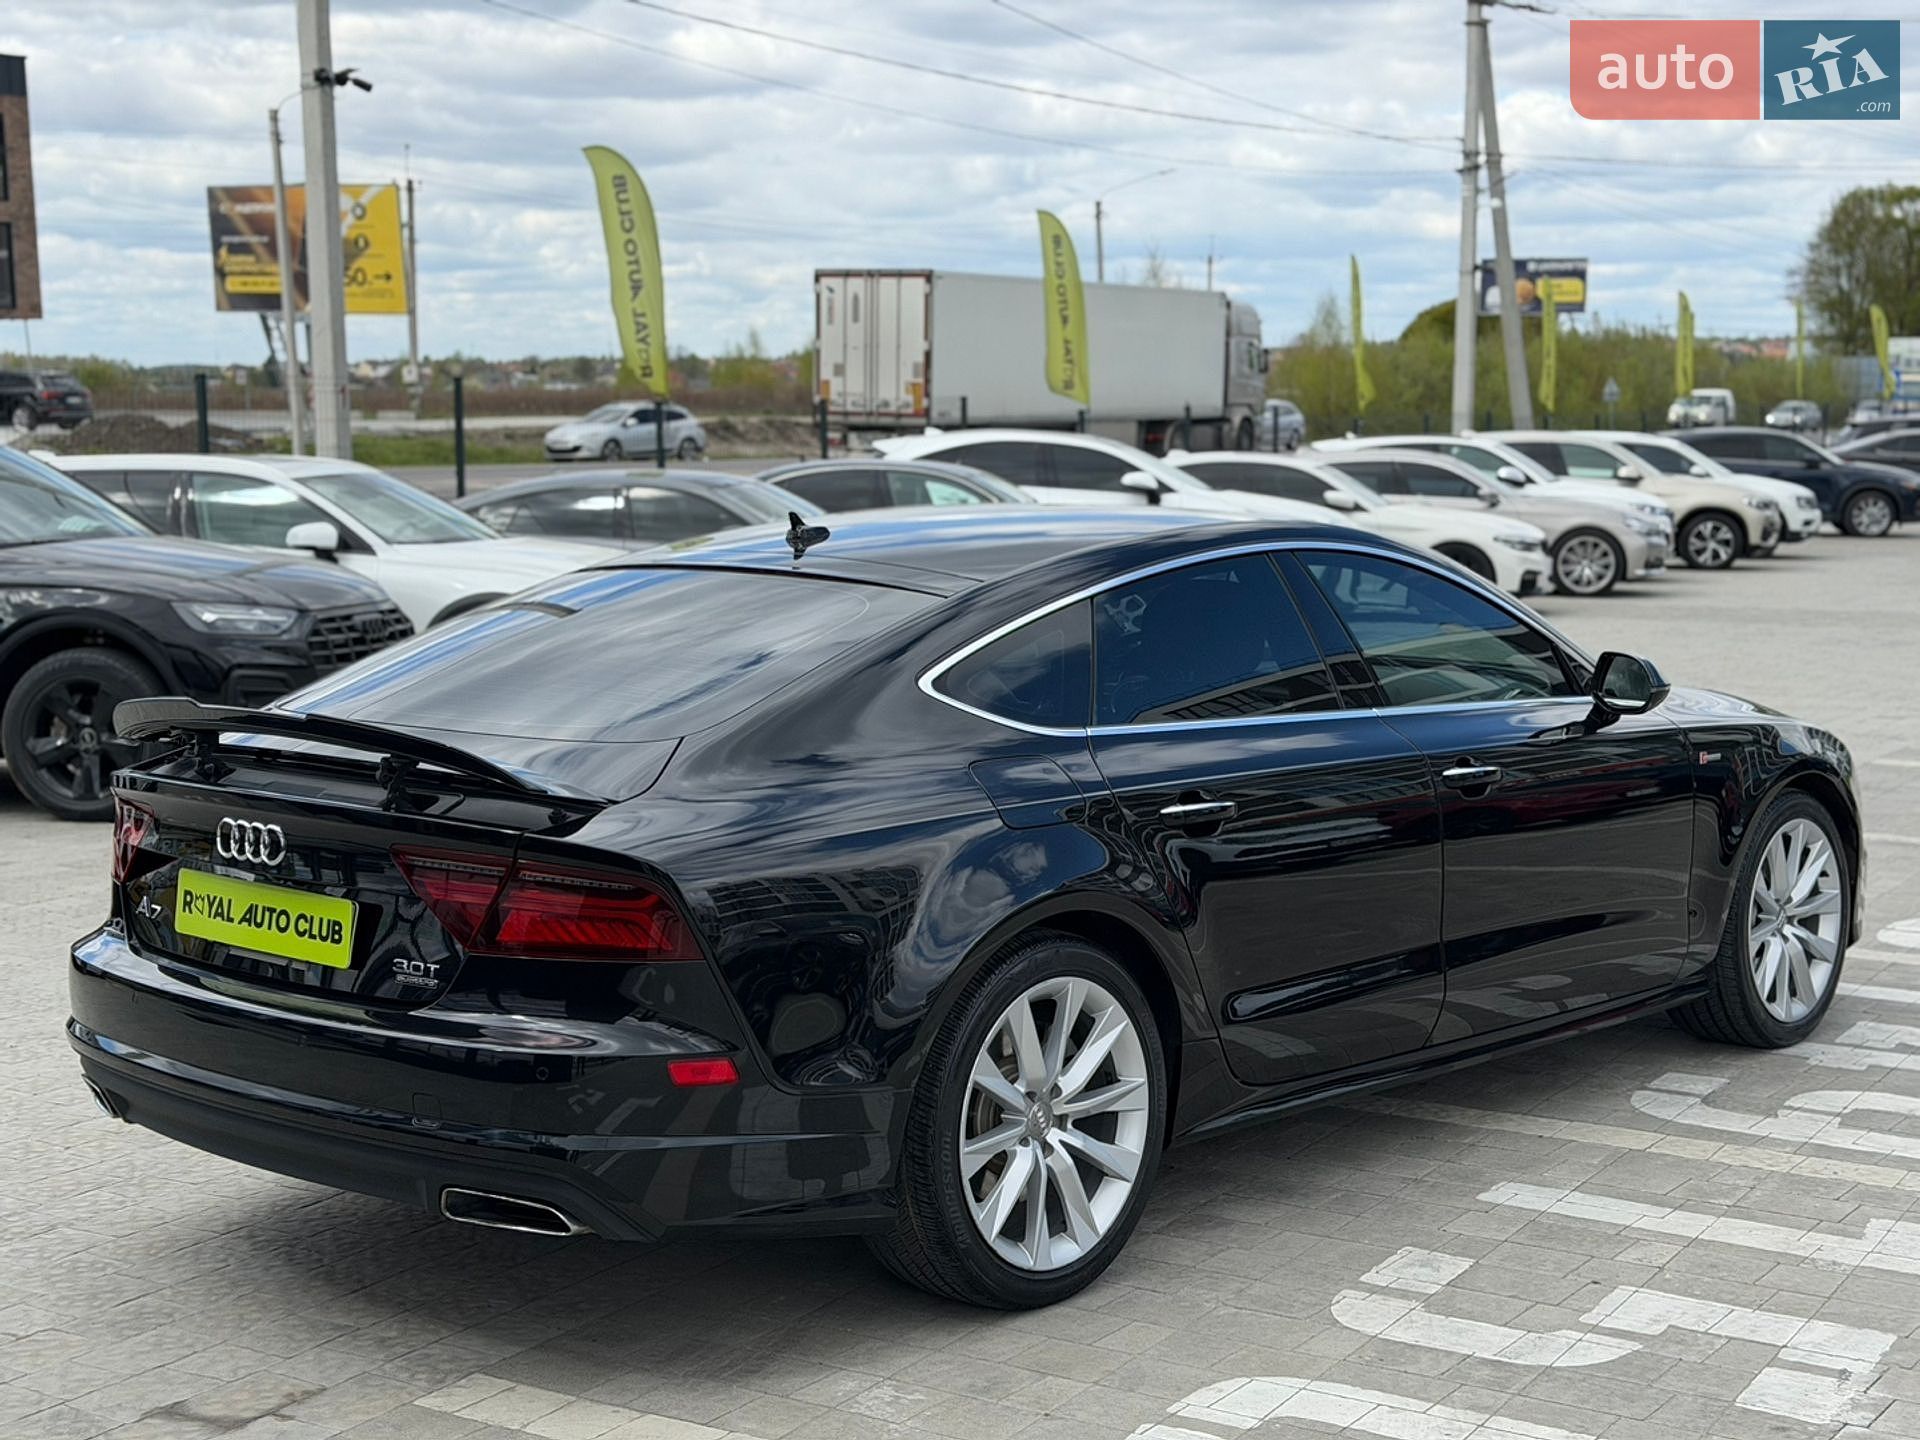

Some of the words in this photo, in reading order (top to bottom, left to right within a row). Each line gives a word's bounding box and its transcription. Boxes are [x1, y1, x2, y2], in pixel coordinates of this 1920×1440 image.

[135, 895, 162, 919] A7
[182, 888, 235, 924] ROYAL
[238, 902, 290, 935] AUTO
[294, 912, 343, 945] CLUB
